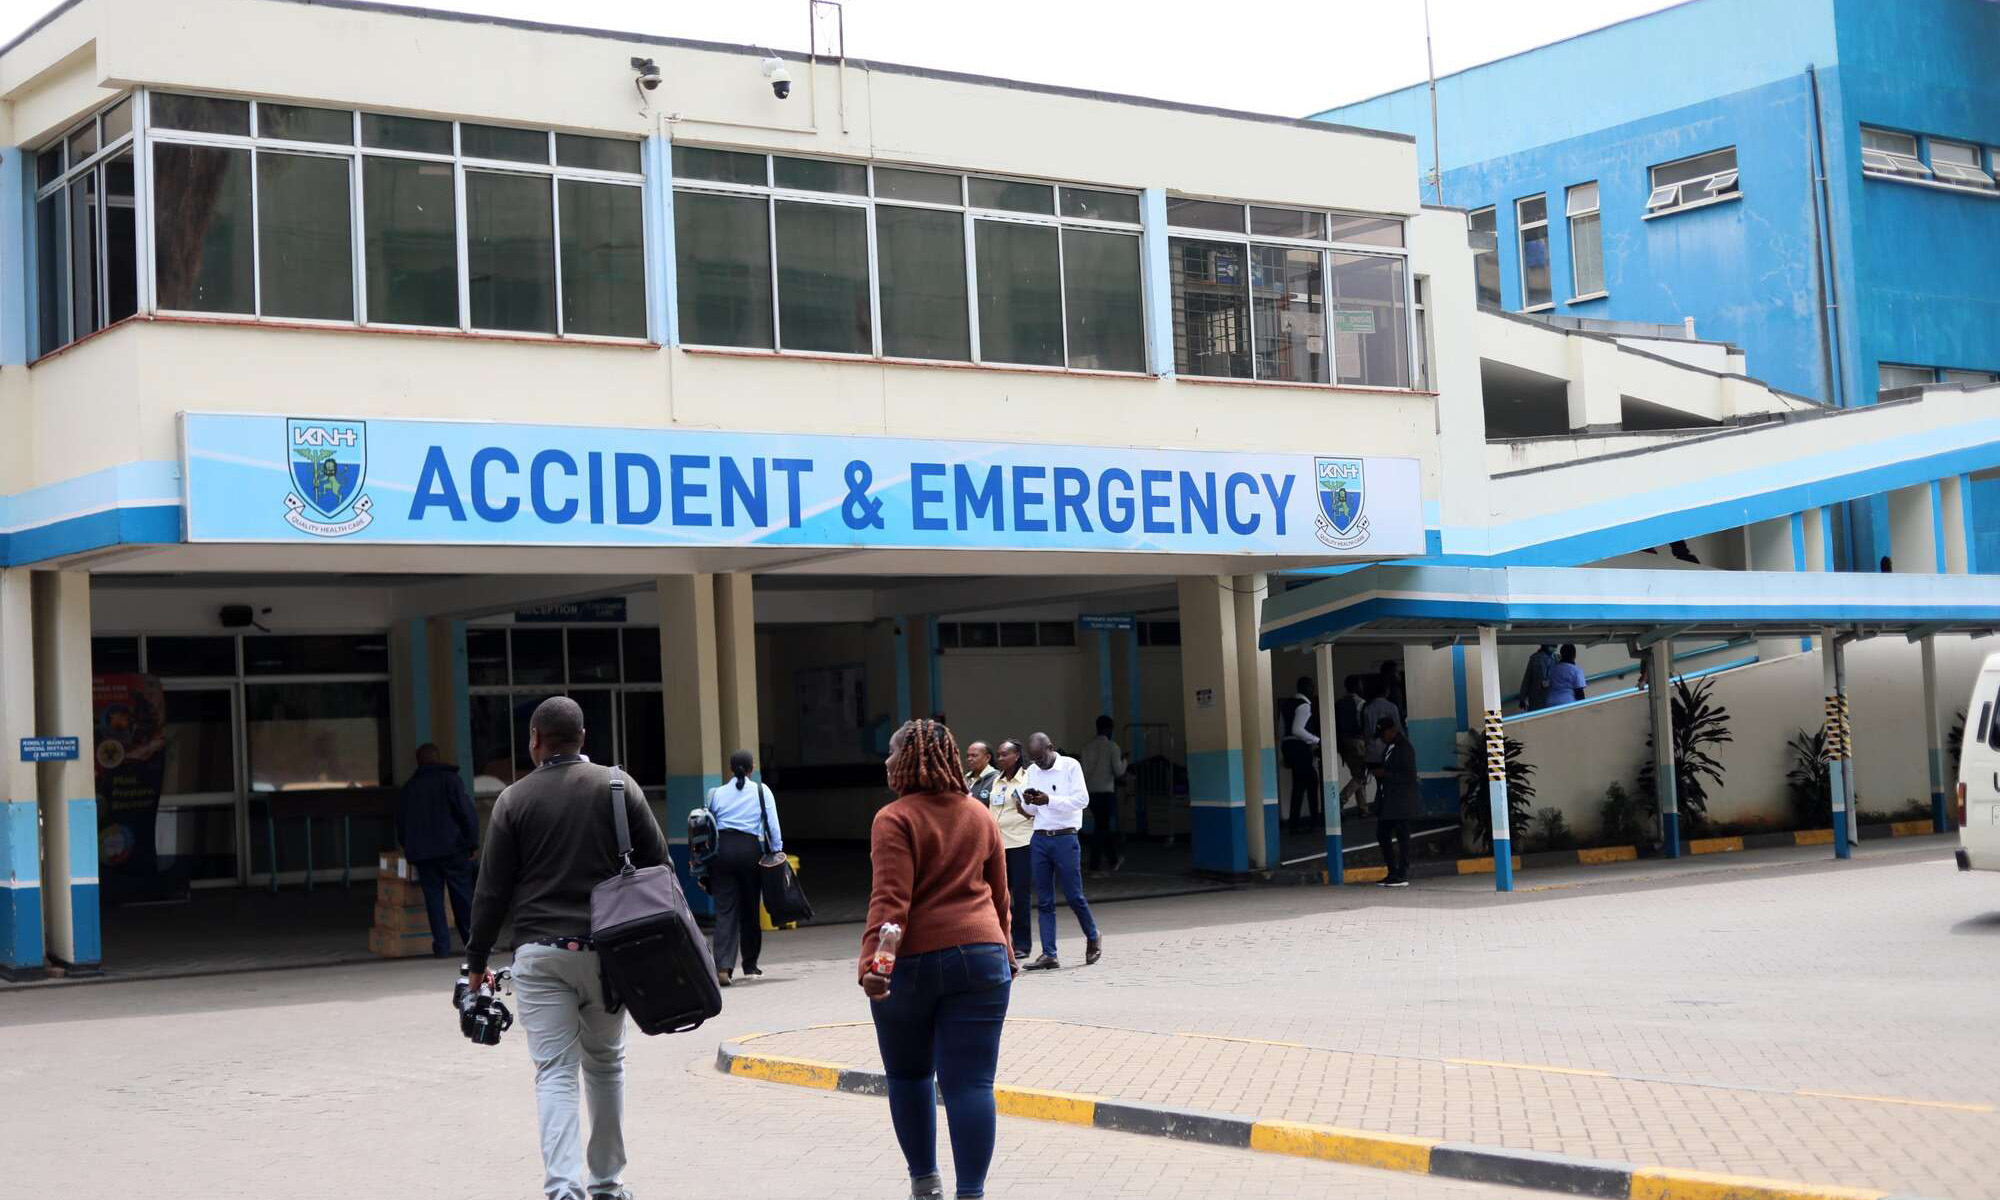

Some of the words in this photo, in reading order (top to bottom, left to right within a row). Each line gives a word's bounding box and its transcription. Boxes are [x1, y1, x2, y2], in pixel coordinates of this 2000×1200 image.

[294, 426, 358, 447] KNH
[407, 445, 814, 529] ACCIDENT
[841, 459, 885, 531] &
[910, 462, 1296, 536] EMERGENCY
[292, 515, 319, 533] QUALITY
[320, 524, 346, 534] HEALTH
[346, 517, 365, 532] CARE
